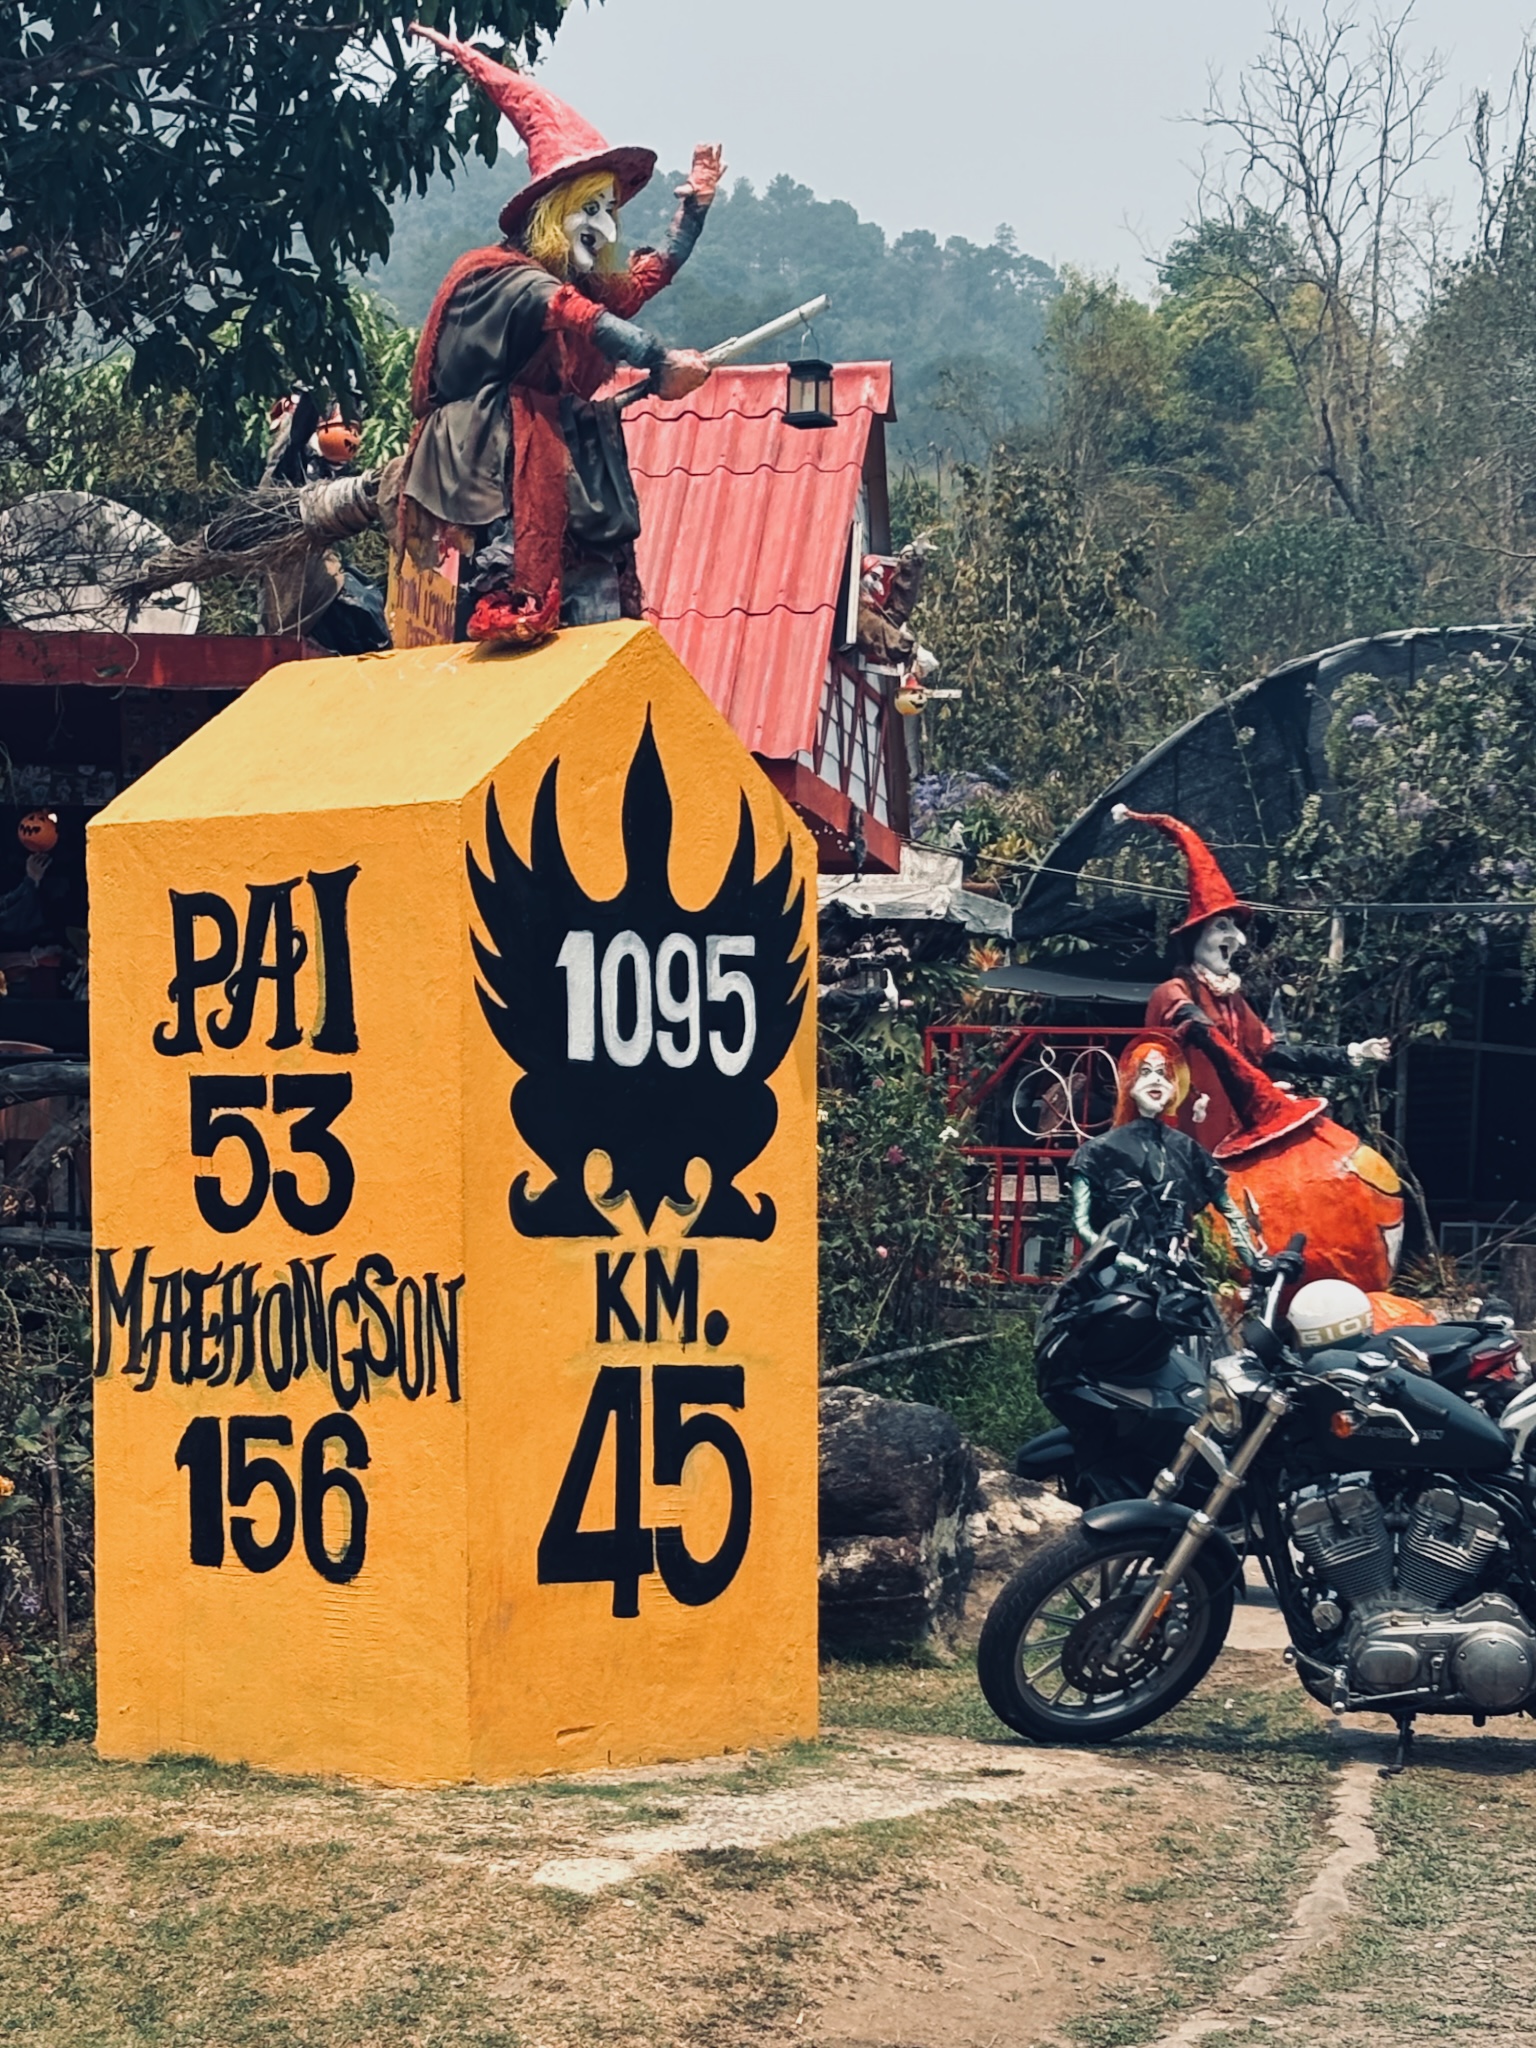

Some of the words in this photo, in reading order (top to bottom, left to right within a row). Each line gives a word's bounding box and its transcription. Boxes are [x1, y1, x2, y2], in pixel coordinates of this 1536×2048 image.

[153, 861, 362, 1056] PAI
[556, 930, 757, 1076] 1095
[189, 1072, 355, 1235] 53
[93, 1246, 466, 1411] MAEHONGSON
[595, 1248, 730, 1348] KM.
[175, 1412, 371, 1584] 156
[538, 1365, 753, 1618] 45
